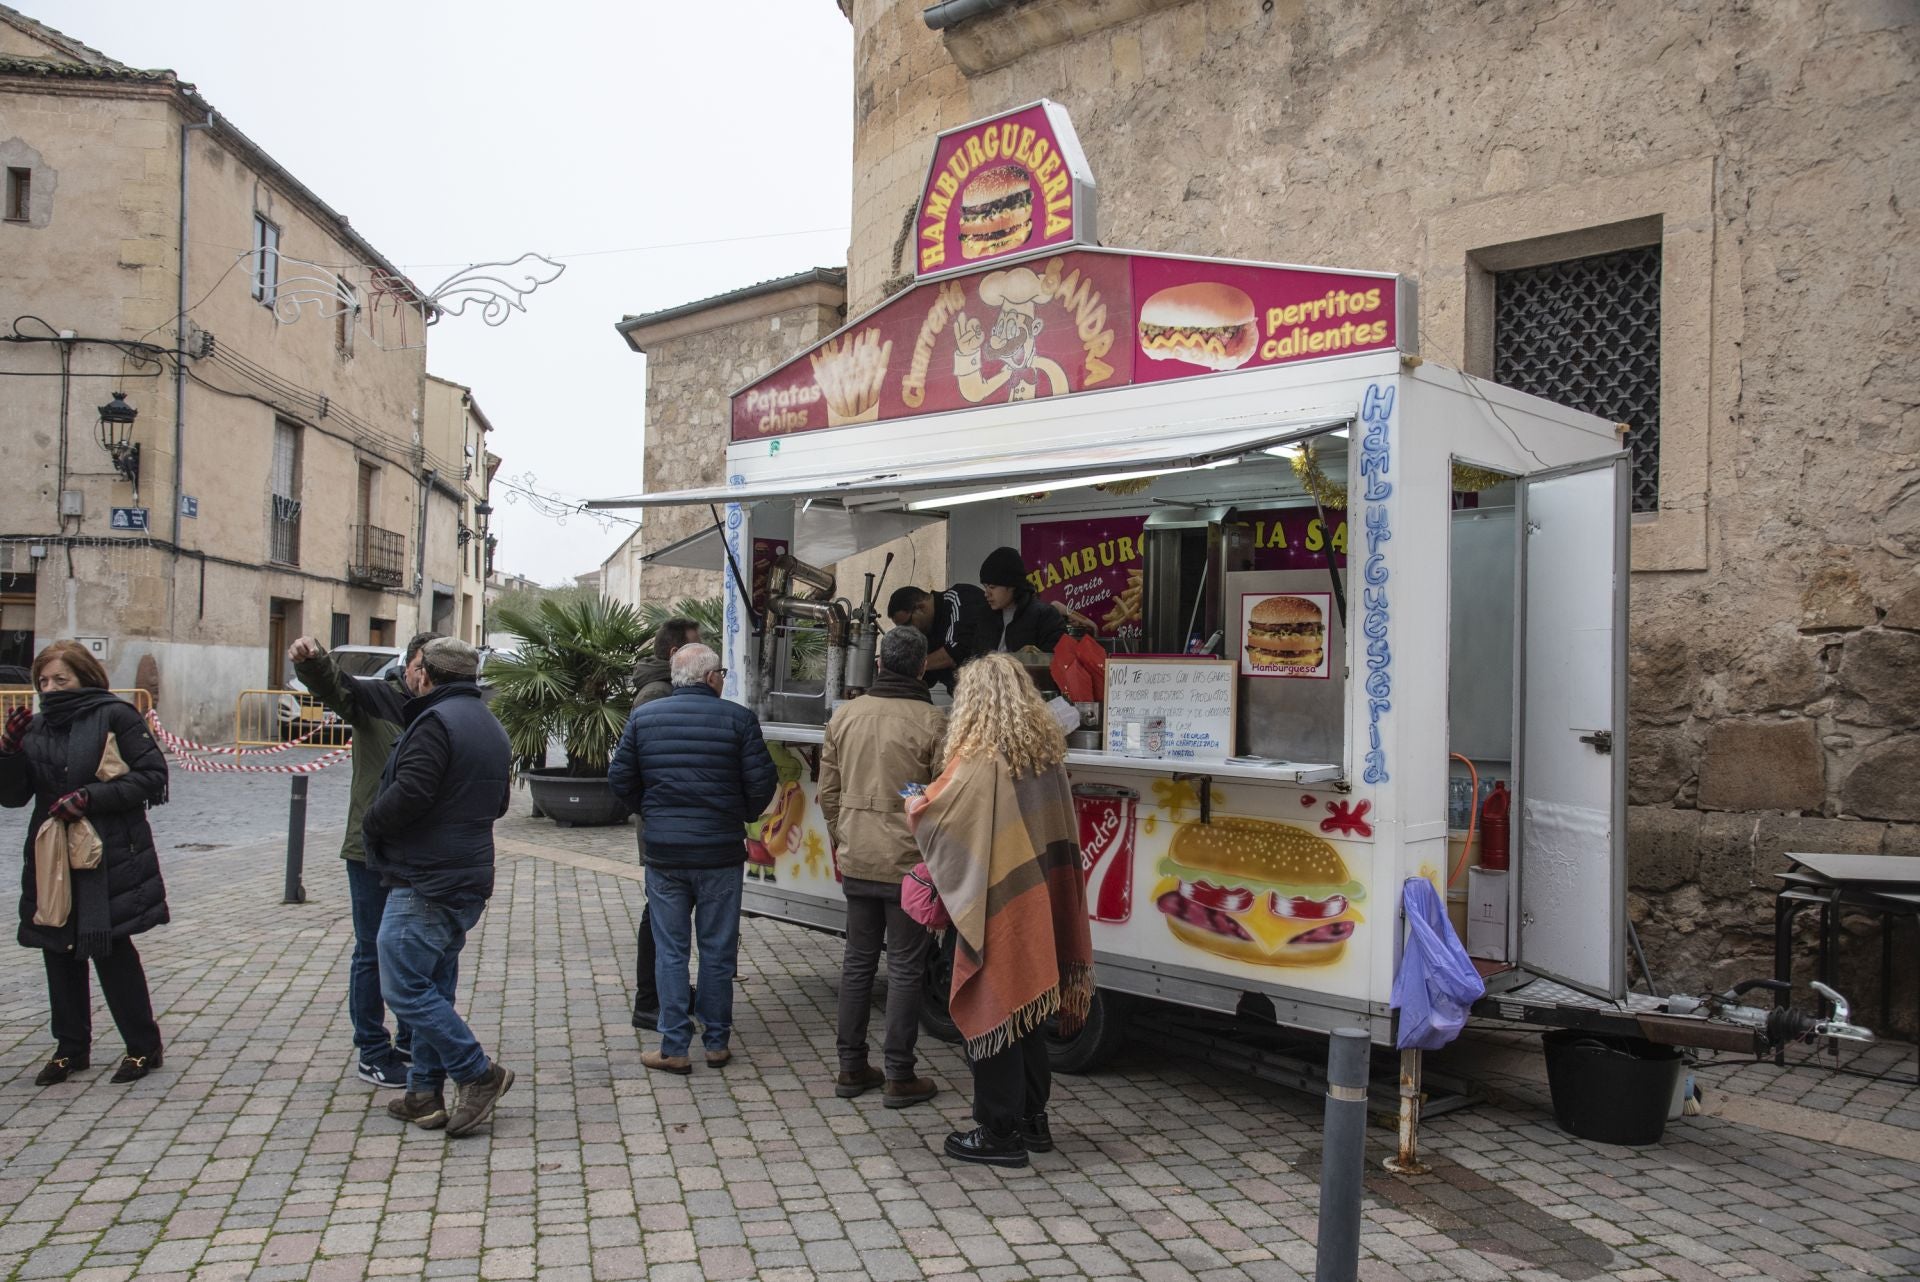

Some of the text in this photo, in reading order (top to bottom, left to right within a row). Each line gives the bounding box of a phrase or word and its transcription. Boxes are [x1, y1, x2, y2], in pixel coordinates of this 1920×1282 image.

[920, 123, 1072, 270] HAMBURGUESERIA
[1041, 256, 1115, 386] SANDRA
[1266, 288, 1381, 337] perritos
[1260, 320, 1387, 360] calientes
[746, 384, 822, 413] Patatas
[758, 408, 809, 433] chips
[1063, 576, 1104, 599] Perrito
[1065, 588, 1112, 615] Caliente
[1132, 669, 1143, 683] TE
[1252, 663, 1317, 675] Hamburguesa
[1080, 808, 1119, 871] andra
